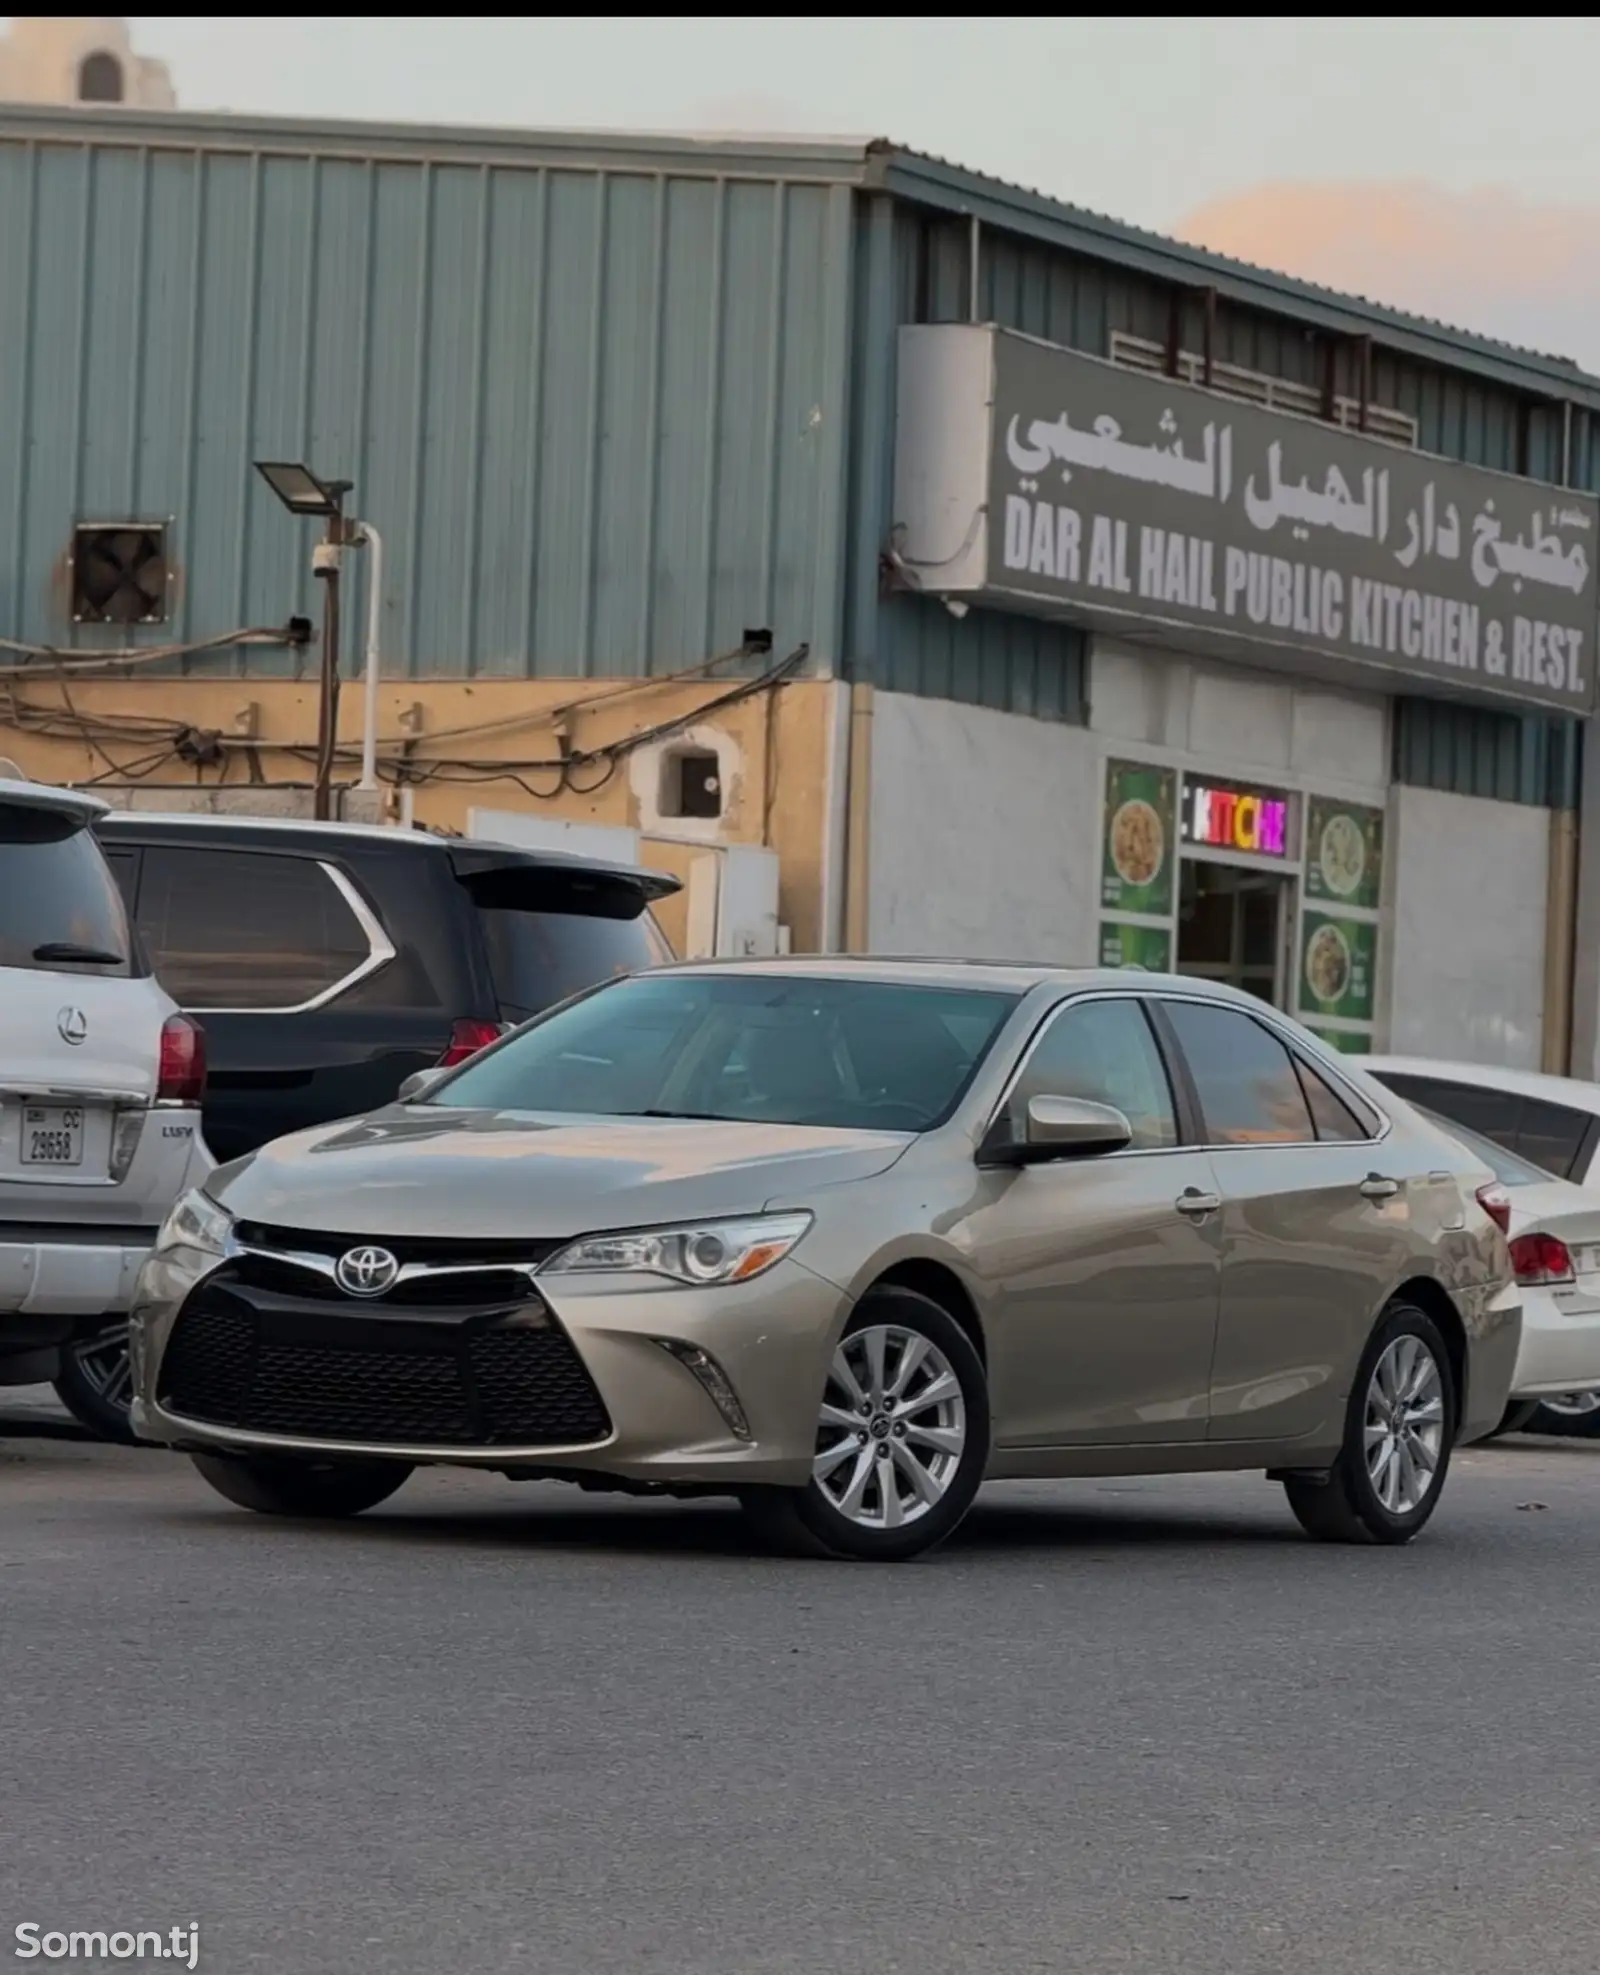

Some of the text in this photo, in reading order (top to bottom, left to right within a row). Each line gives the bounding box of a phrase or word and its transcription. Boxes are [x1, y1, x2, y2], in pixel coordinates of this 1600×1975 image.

[1004, 494, 1585, 693] DAR AL HAIL PUBLIC KITCHEN & REST.
[1006, 408, 1589, 595] مطبخ دار الهيل الشعبي
